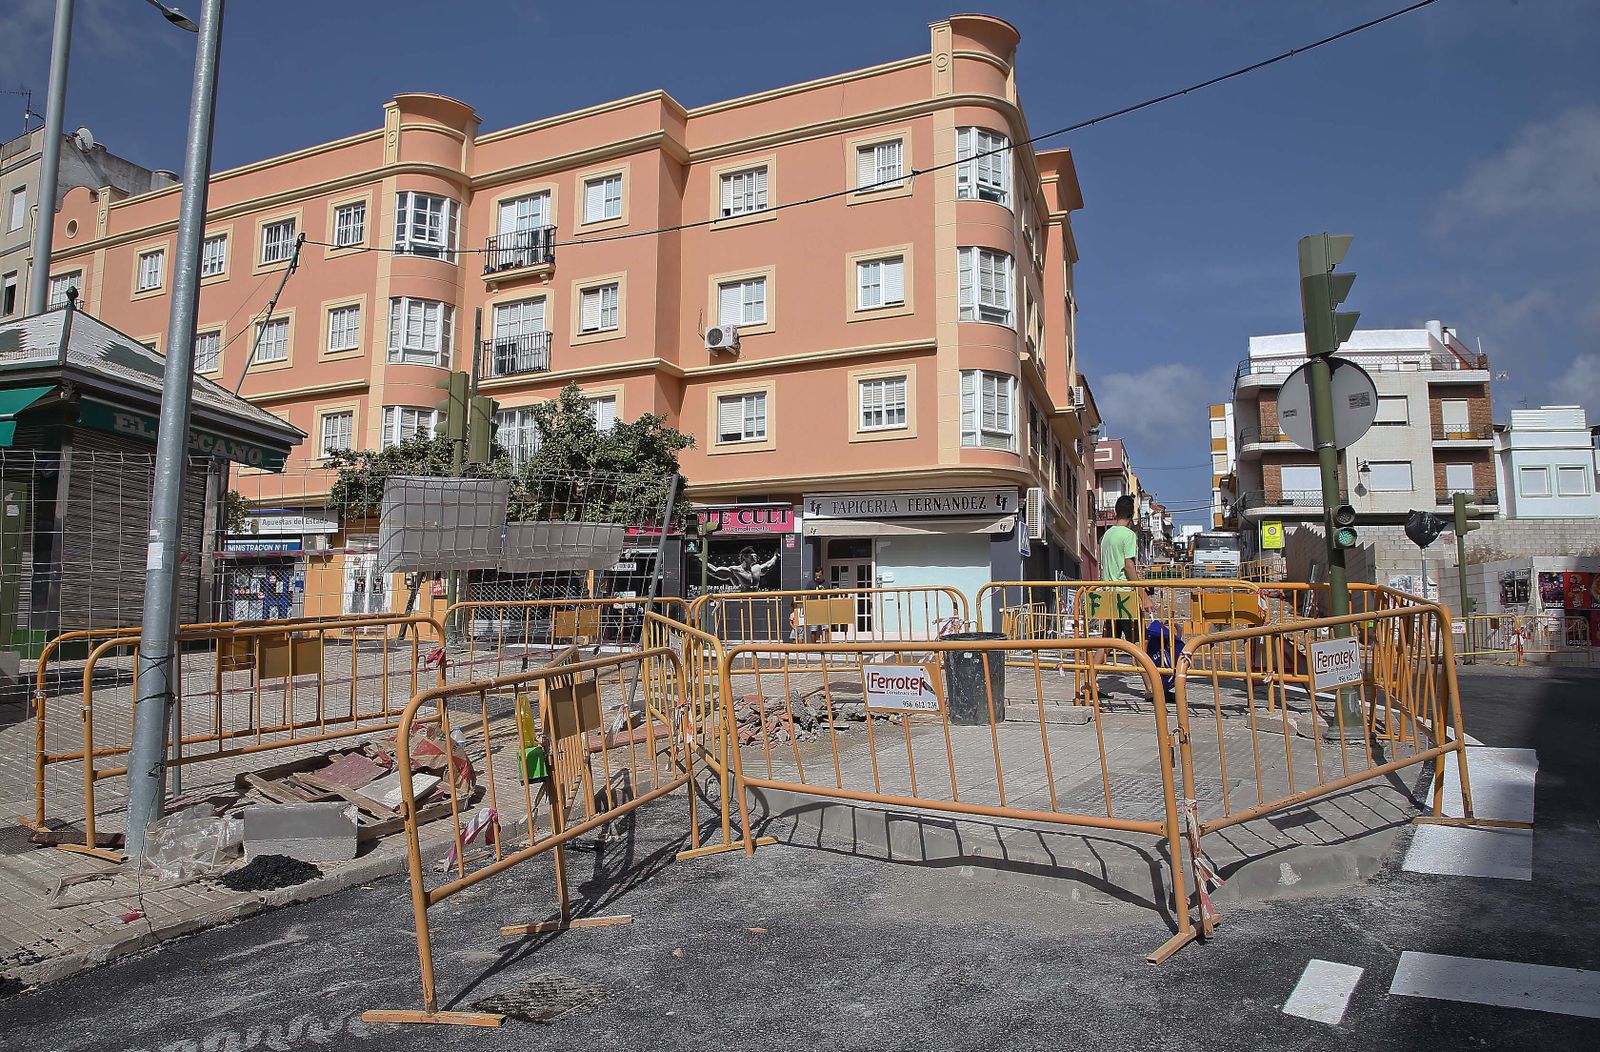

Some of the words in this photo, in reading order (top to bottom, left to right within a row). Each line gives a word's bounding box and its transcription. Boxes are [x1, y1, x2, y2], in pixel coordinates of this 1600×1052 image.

[113, 412, 158, 439] EL
[187, 431, 263, 464] ECANO
[831, 499, 898, 515] TAPICERIA
[908, 496, 987, 512] FERNANDEZ
[995, 494, 1008, 511] tf
[262, 518, 292, 527] Apuestas
[737, 509, 790, 525] CULT
[224, 544, 273, 552] MINISTRACION
[282, 543, 288, 551] 11
[1088, 592, 1102, 617] F
[1117, 593, 1132, 619] K
[1317, 649, 1355, 669] Ferrotek
